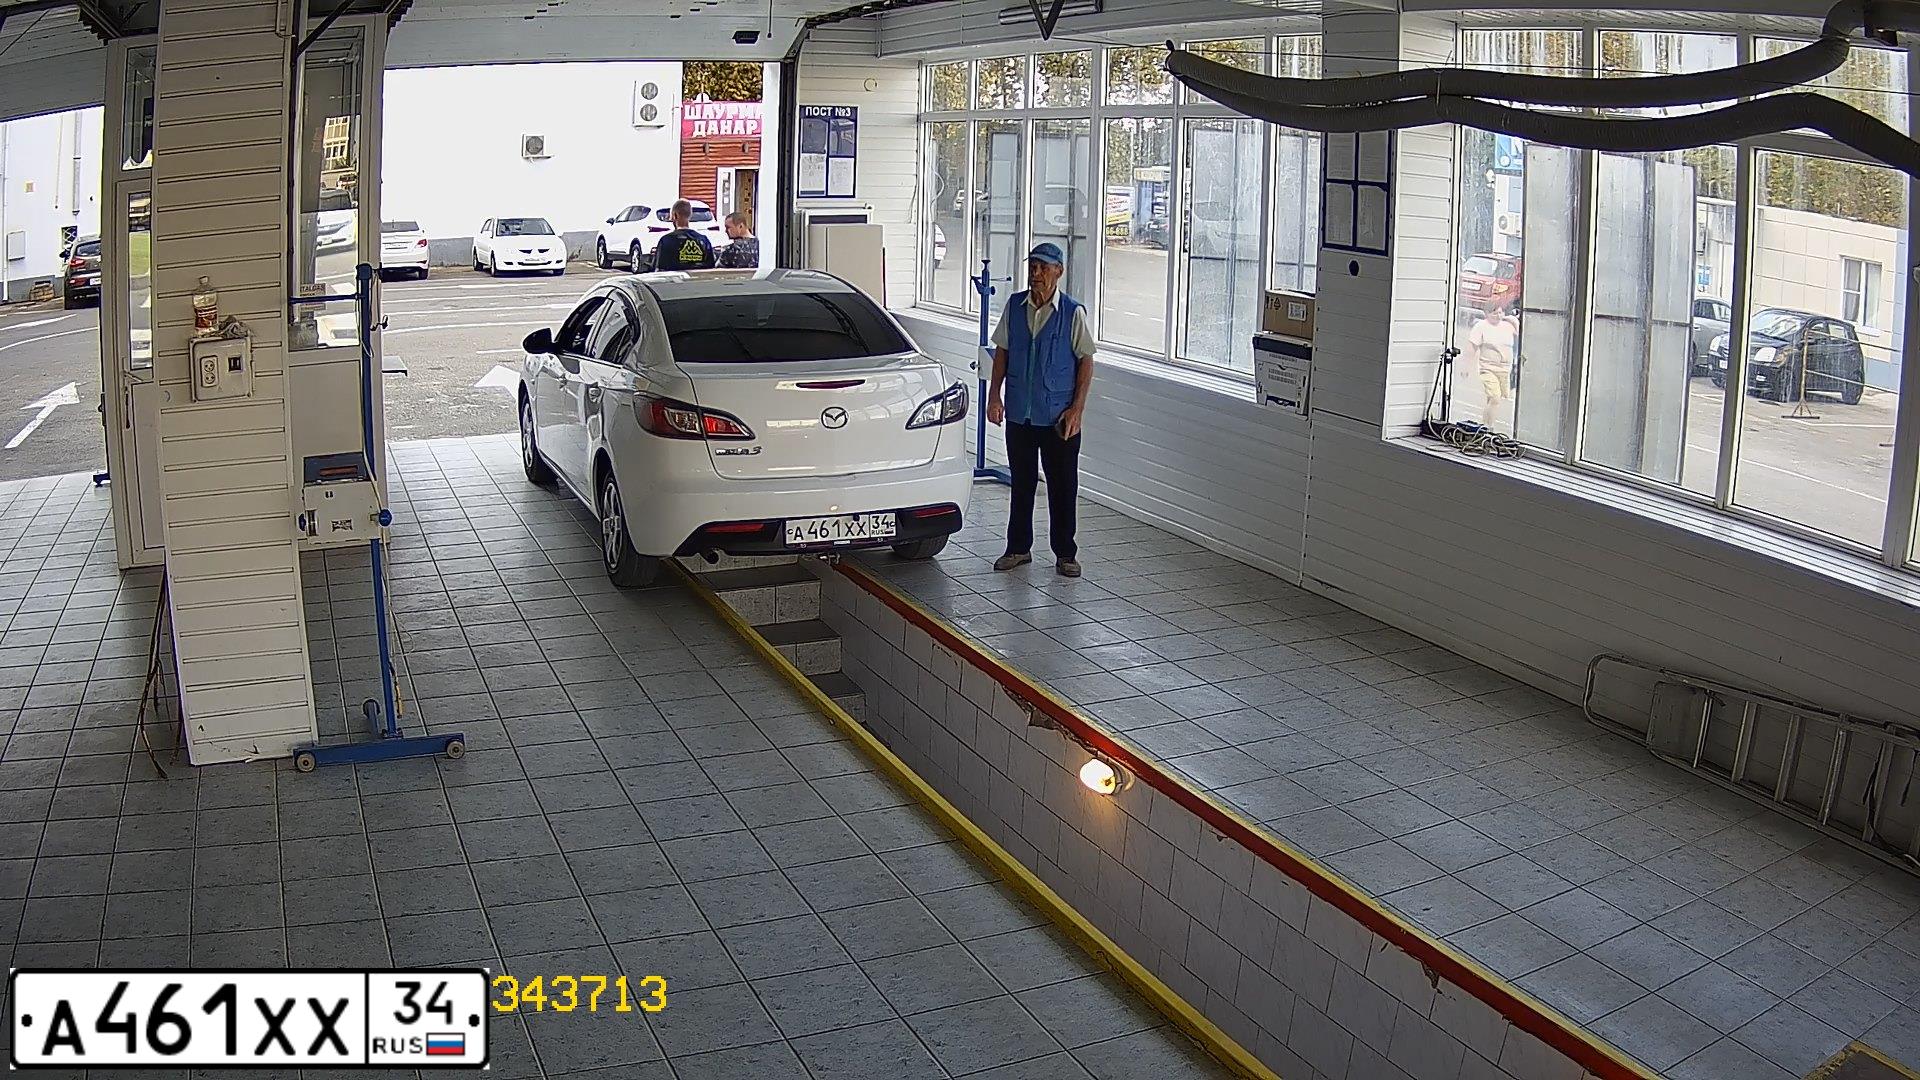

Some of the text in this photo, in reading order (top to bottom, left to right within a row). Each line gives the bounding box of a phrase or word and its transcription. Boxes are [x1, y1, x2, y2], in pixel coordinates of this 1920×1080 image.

[805, 106, 851, 117] ПОСТ №3
[871, 515, 890, 530] 34
